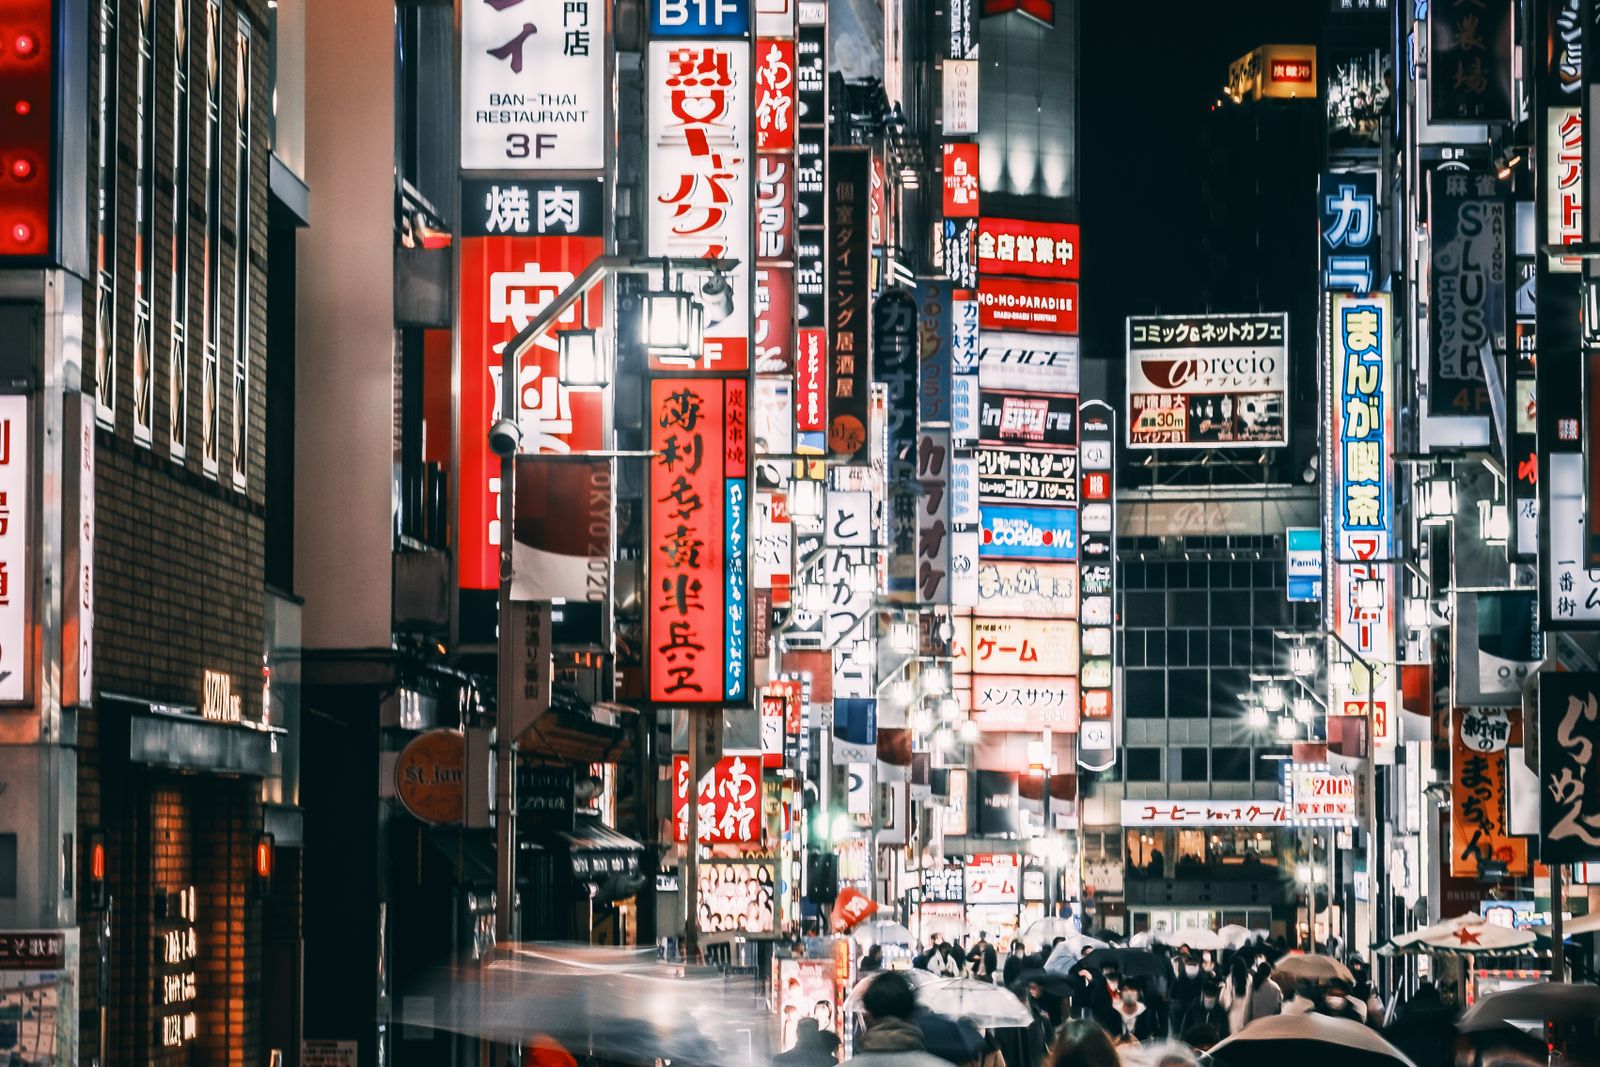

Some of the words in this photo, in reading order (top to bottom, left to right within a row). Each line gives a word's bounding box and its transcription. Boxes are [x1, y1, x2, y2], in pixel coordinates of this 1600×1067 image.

[659, 0, 737, 25] B1F
[476, 111, 588, 123] RESTAURANT
[506, 134, 557, 158] 3F
[485, 186, 580, 233] 焼肉
[978, 231, 1074, 266] 全店営業中
[1133, 322, 1281, 342] コミック&ネットカフェ
[1168, 350, 1275, 386] aprecio
[1202, 376, 1273, 387] アプレシオ
[1344, 309, 1383, 525] まんが喫茶
[1557, 560, 1577, 617] 一番街
[1460, 756, 1495, 861] まっちゃん
